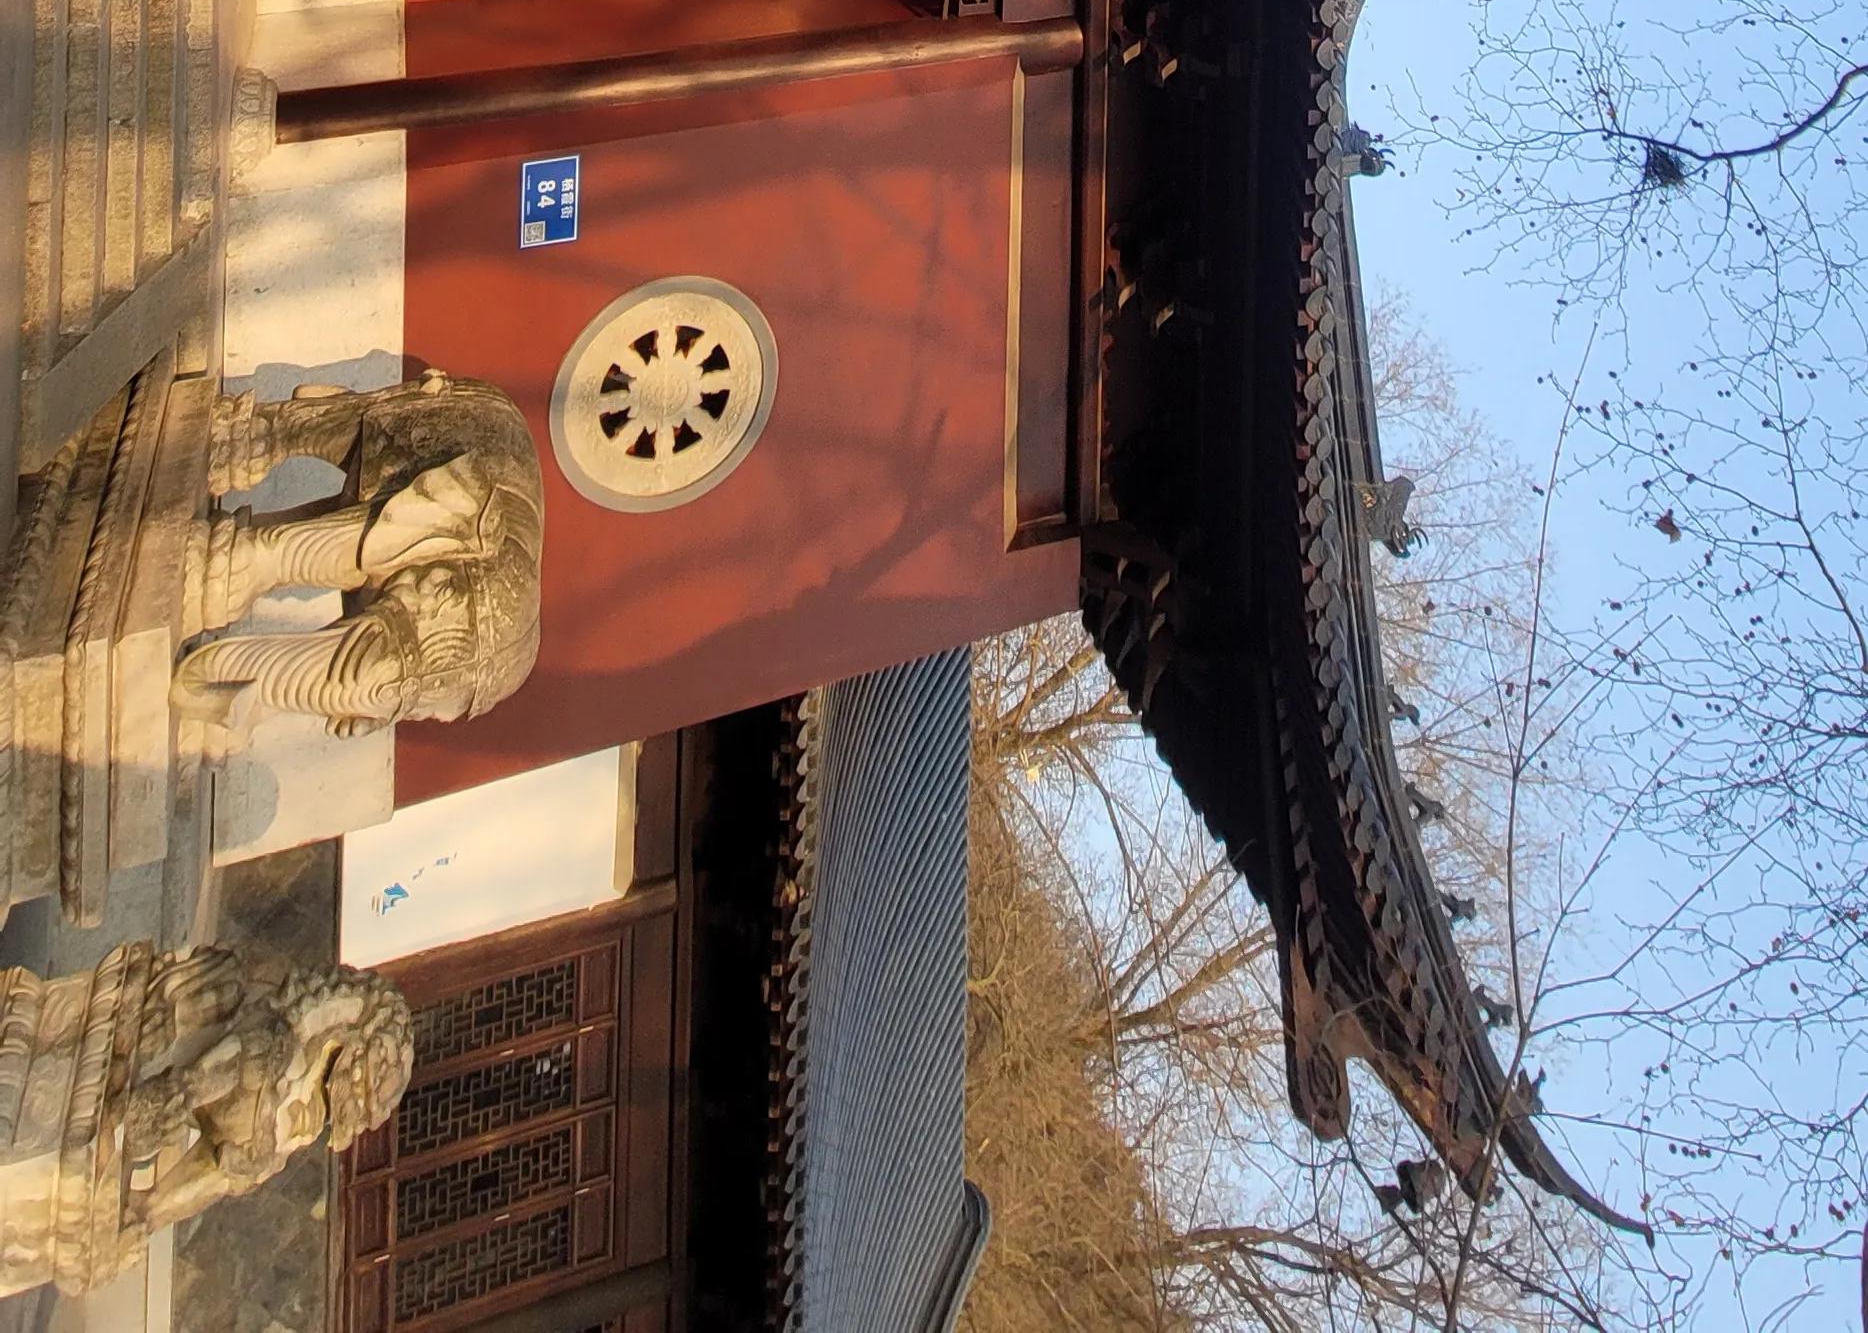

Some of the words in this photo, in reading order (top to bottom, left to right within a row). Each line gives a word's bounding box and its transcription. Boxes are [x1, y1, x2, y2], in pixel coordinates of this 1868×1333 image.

[537, 179, 556, 209] 84
[560, 178, 574, 220] 栖霞街
